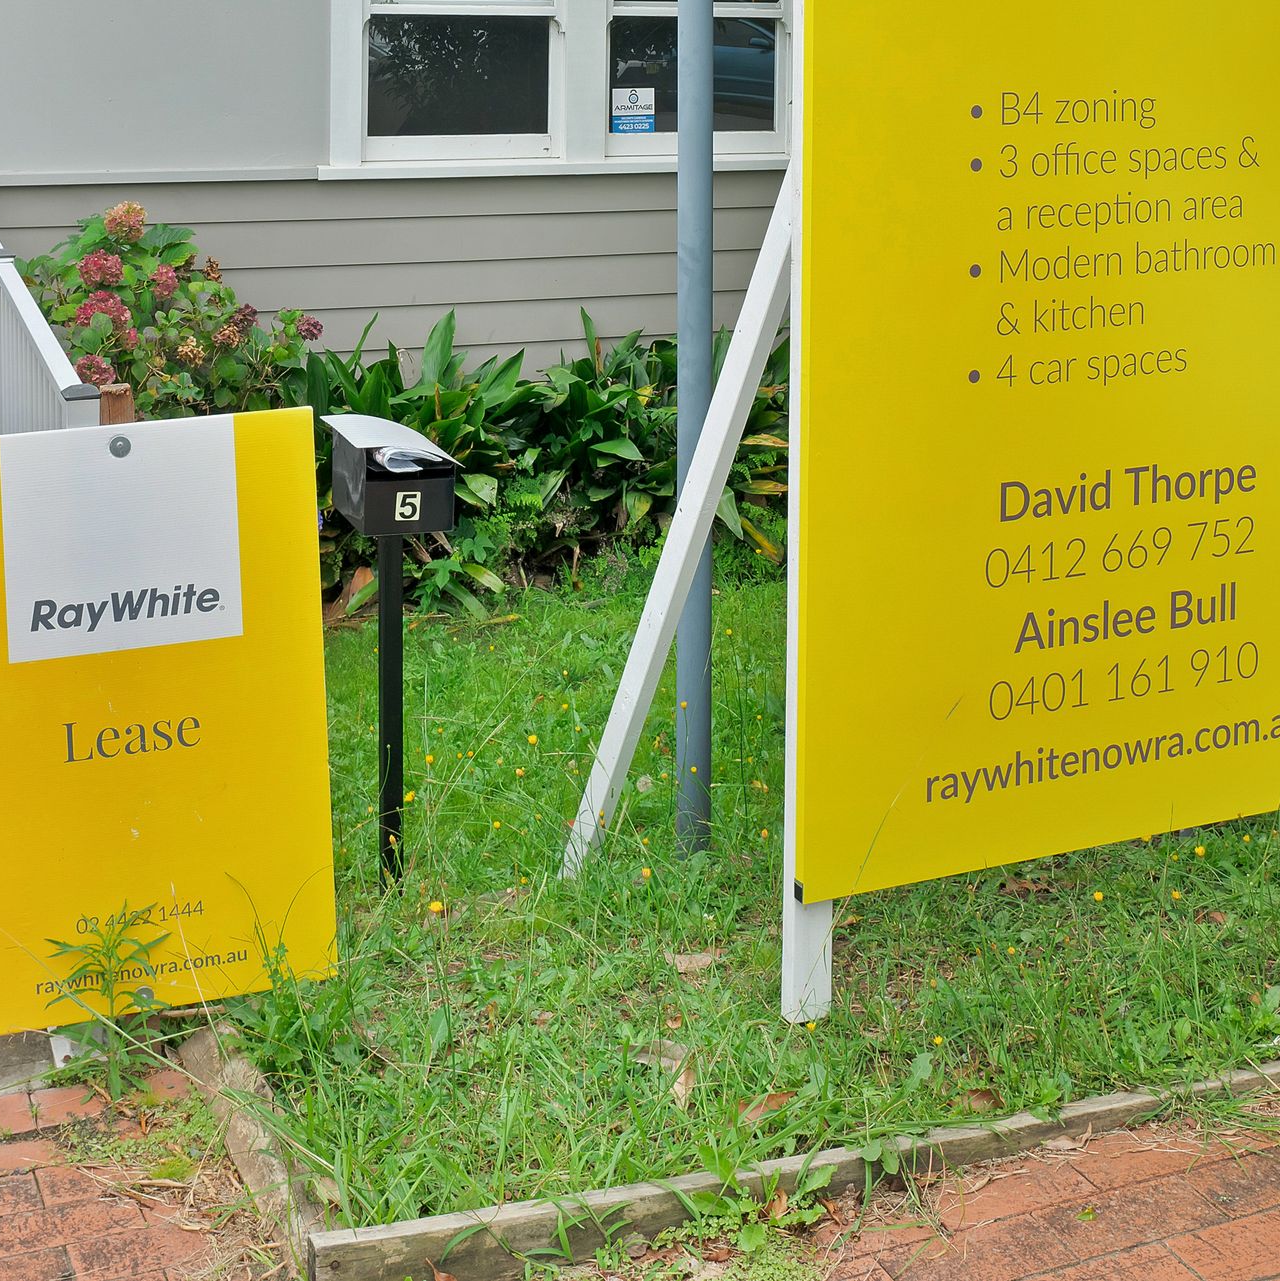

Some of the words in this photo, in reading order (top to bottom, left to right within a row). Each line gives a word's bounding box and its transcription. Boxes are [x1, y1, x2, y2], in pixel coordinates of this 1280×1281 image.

[1001, 91, 1044, 126] B4
[1054, 89, 1157, 130] zoning
[999, 144, 1019, 179] 3
[1031, 141, 1117, 177] office
[1128, 143, 1227, 180] spaces
[1238, 135, 1261, 169] &
[996, 206, 1013, 232] a
[1026, 191, 1171, 234] reception
[1182, 195, 1243, 221] area
[999, 245, 1122, 284] Modern
[1135, 238, 1276, 275] bathroom
[996, 301, 1022, 337] &
[1033, 295, 1145, 334] kitchen
[995, 354, 1018, 388] 4
[1029, 357, 1078, 386] car
[1086, 348, 1188, 387] spaces
[398, 494, 418, 519] 5
[999, 468, 1112, 523] David
[1124, 463, 1257, 507] Thorpe
[985, 537, 1087, 589] 0412
[1102, 527, 1173, 573] 669
[1187, 516, 1255, 561] 752
[30, 583, 220, 633] RayWhite
[1013, 599, 1156, 655] Ainslee
[1169, 581, 1237, 630] Bull
[989, 667, 1089, 721] 0401
[1107, 654, 1175, 703] 161
[1190, 640, 1259, 688] 910
[62, 716, 202, 764] Lease
[159, 900, 205, 922] 1444
[35, 948, 248, 996] raywhienowra.com.au
